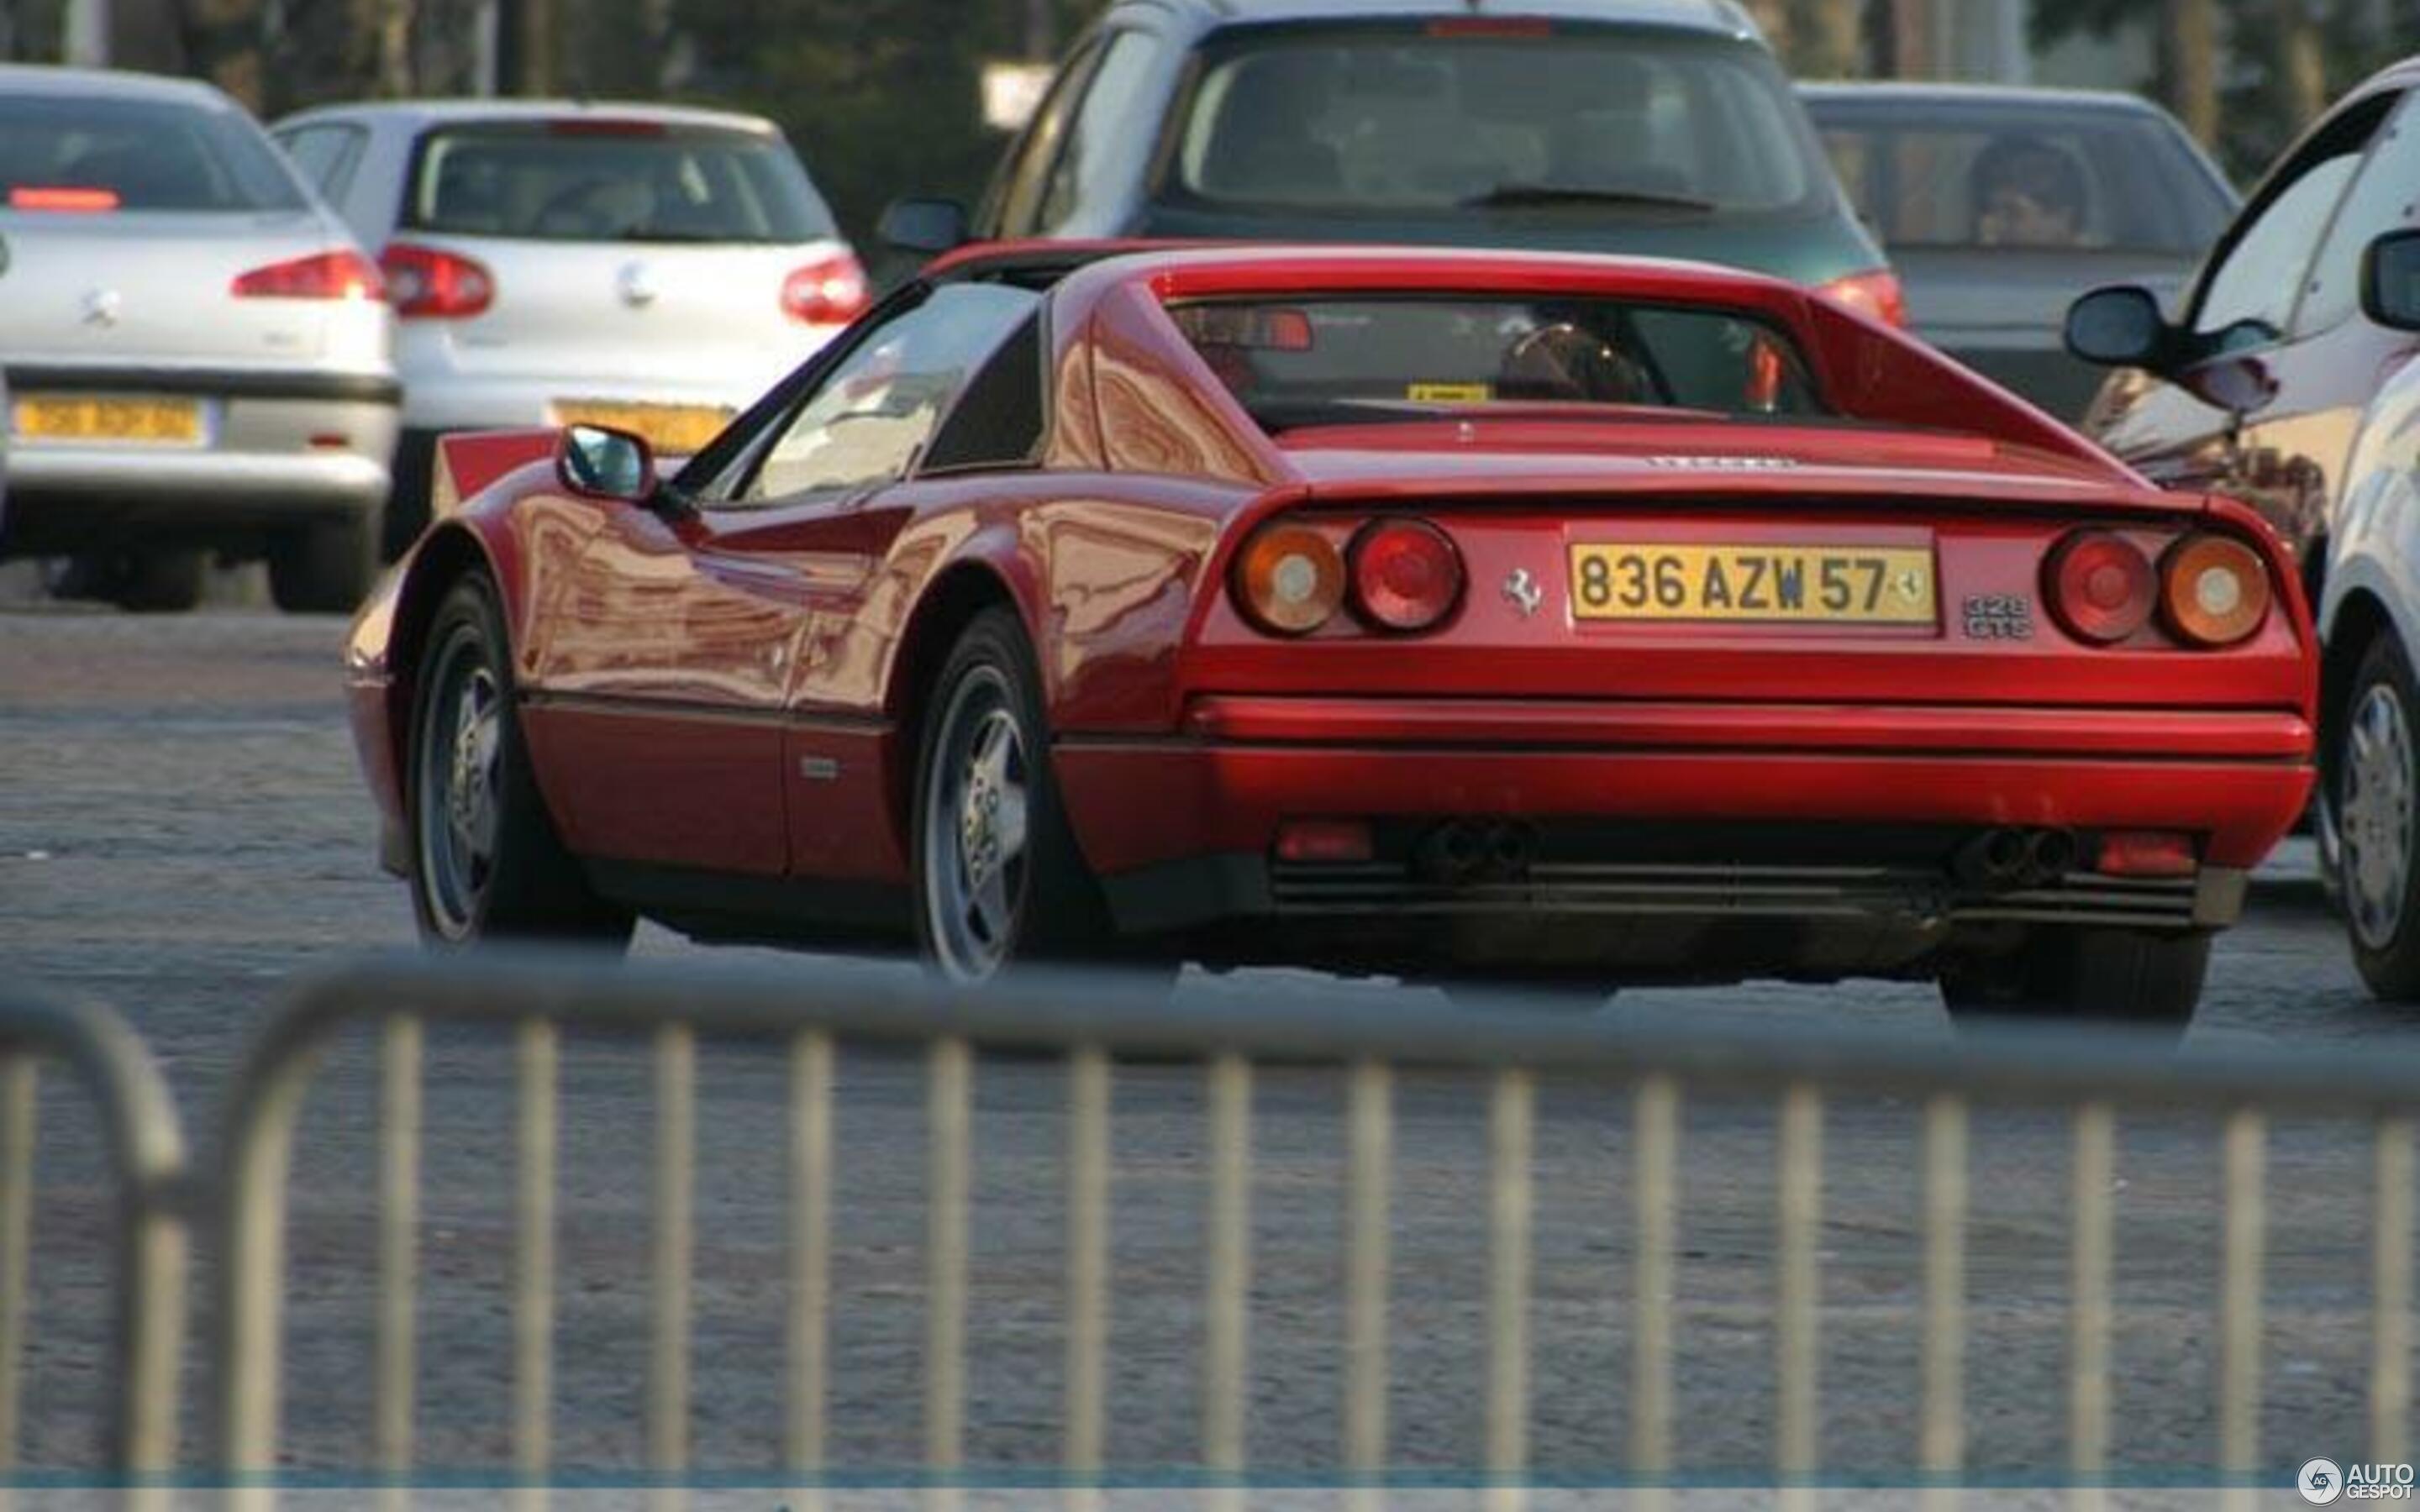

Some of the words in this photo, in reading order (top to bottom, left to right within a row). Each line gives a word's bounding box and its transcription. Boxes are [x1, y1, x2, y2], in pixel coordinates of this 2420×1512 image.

[1581, 554, 1686, 607] 836
[1702, 556, 1804, 610] AZW
[1820, 559, 1887, 612] 57
